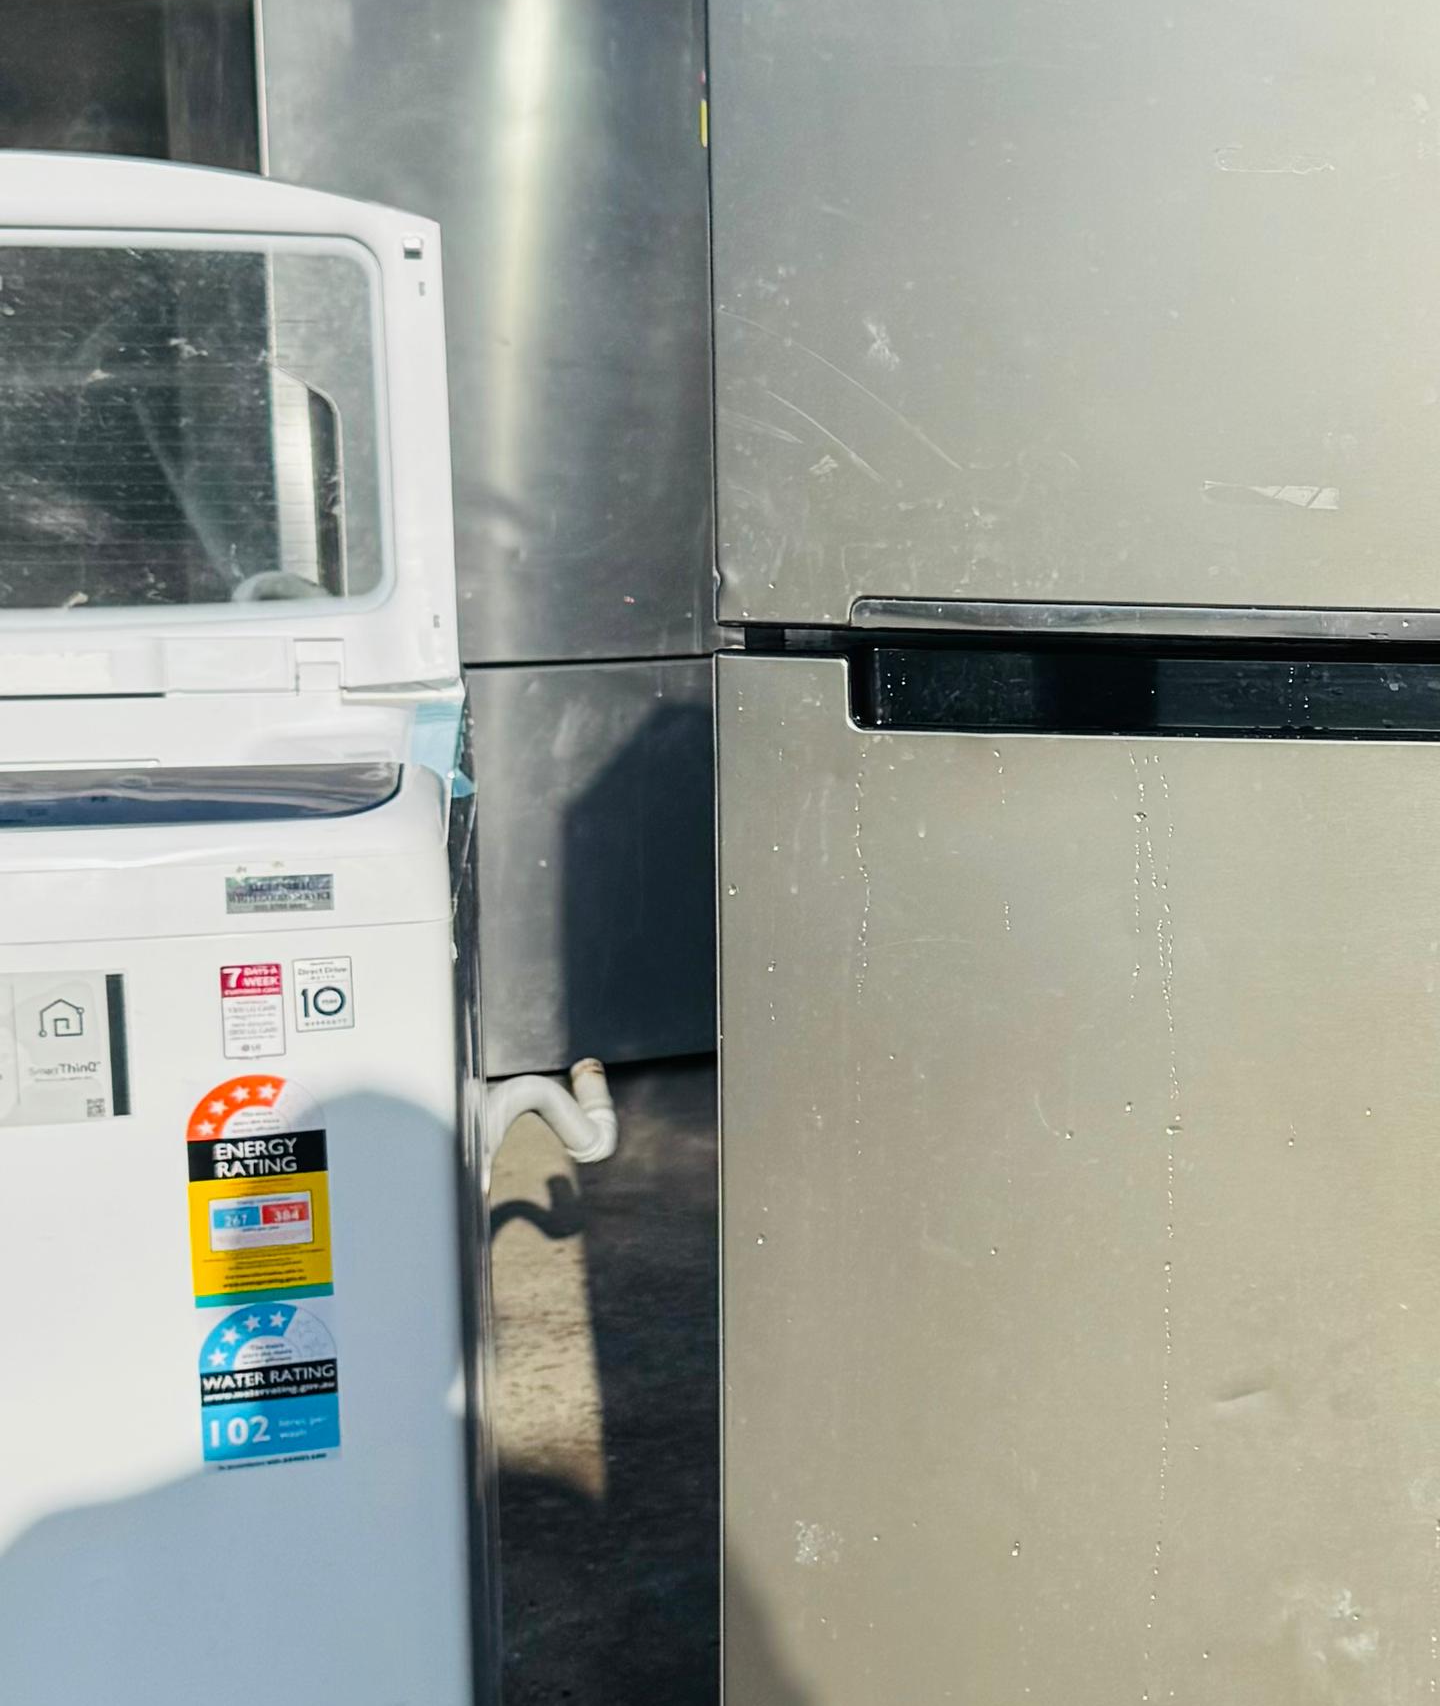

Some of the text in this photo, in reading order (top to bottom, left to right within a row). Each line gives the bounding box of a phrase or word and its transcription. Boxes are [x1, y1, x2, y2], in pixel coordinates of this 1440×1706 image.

[222, 967, 243, 988] 7
[242, 976, 280, 988] WEEK
[301, 986, 347, 1018] 10
[213, 1137, 297, 1160] ENERGY
[214, 1156, 298, 1178] RATING
[203, 1363, 335, 1391] WATER RATING
[210, 1415, 271, 1448] 102
